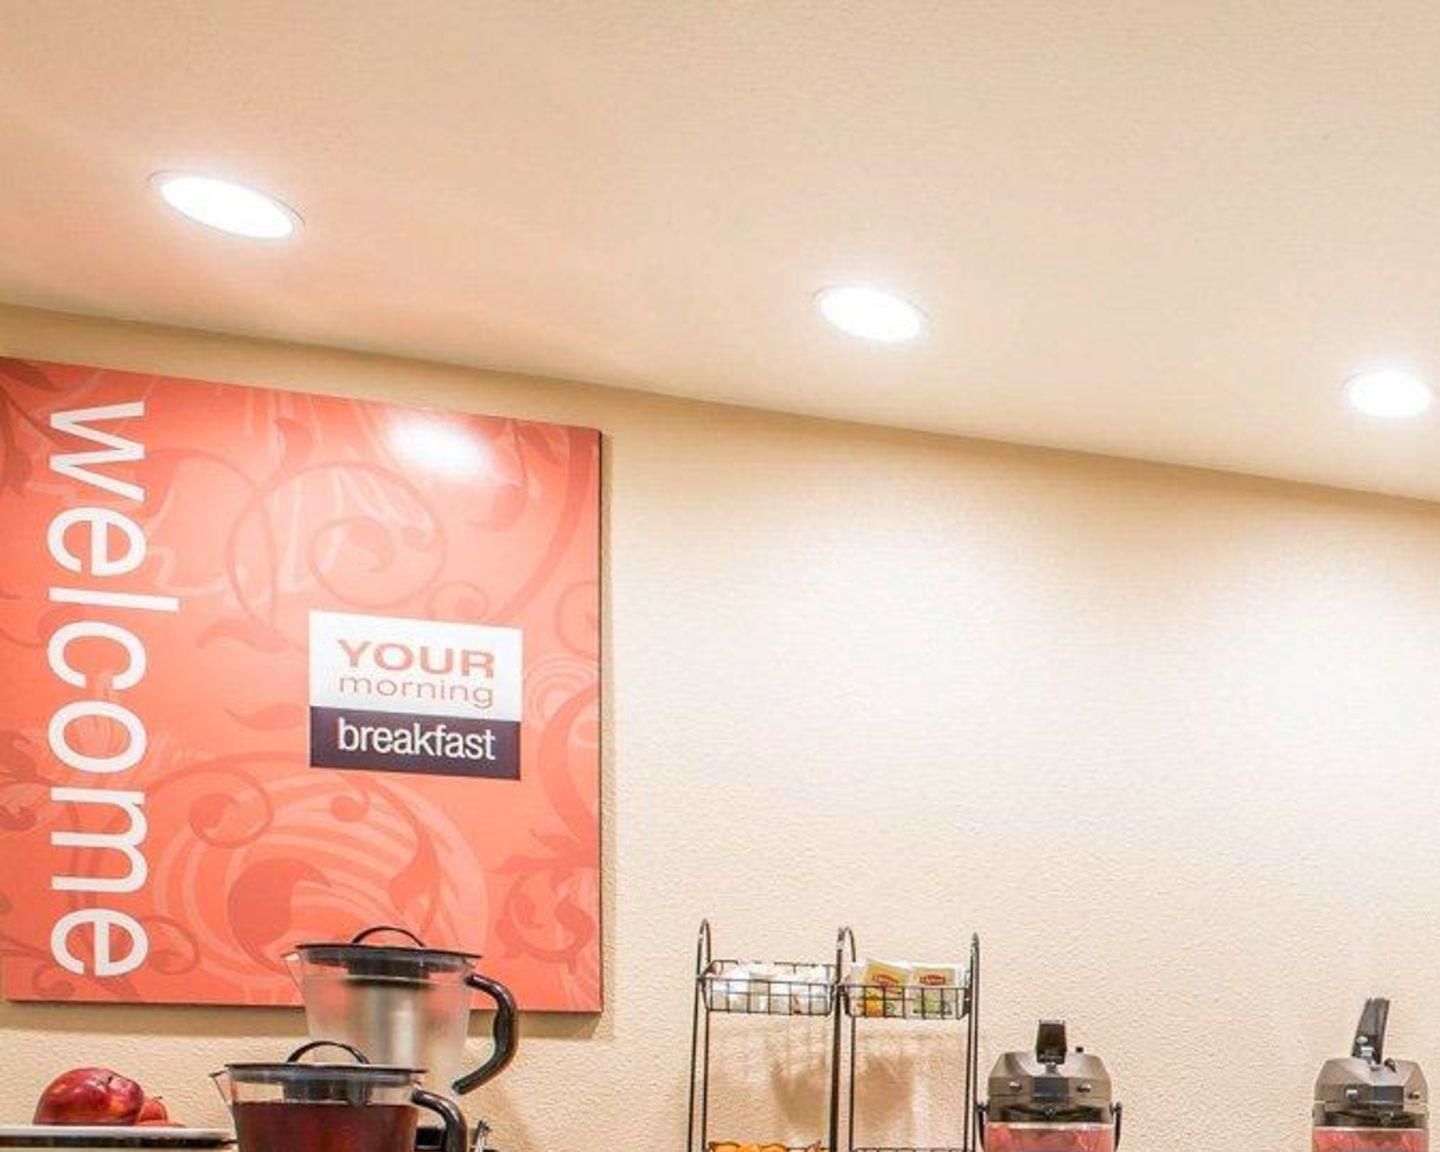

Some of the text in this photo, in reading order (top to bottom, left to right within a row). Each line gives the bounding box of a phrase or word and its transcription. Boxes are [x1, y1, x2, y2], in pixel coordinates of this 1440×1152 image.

[337, 638, 495, 678] YOUR
[47, 400, 180, 977] welcome
[338, 676, 495, 710] morning
[337, 716, 496, 761] breakfast
